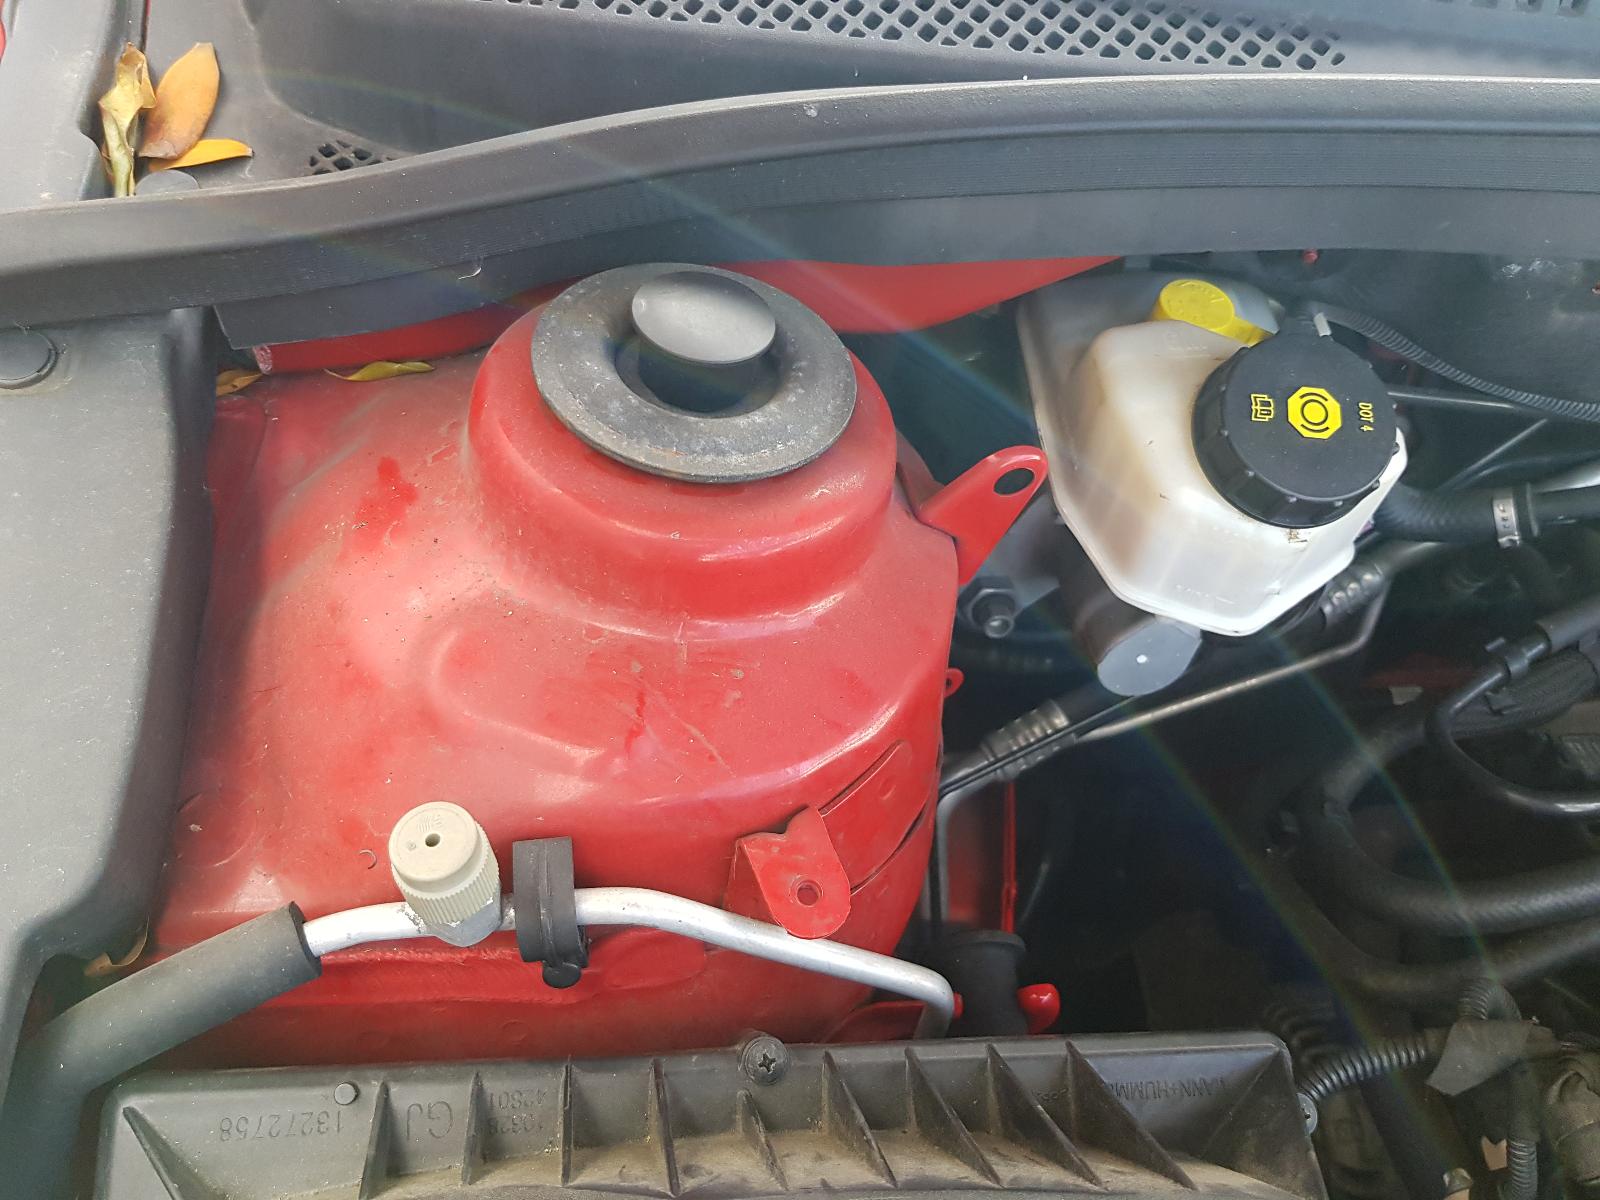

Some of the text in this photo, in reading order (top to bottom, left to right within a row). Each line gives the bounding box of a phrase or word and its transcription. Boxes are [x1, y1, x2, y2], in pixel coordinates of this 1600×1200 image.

[1358, 402, 1375, 432] DOT 4
[218, 1109, 344, 1143] 13272758
[405, 1100, 453, 1140] GJ
